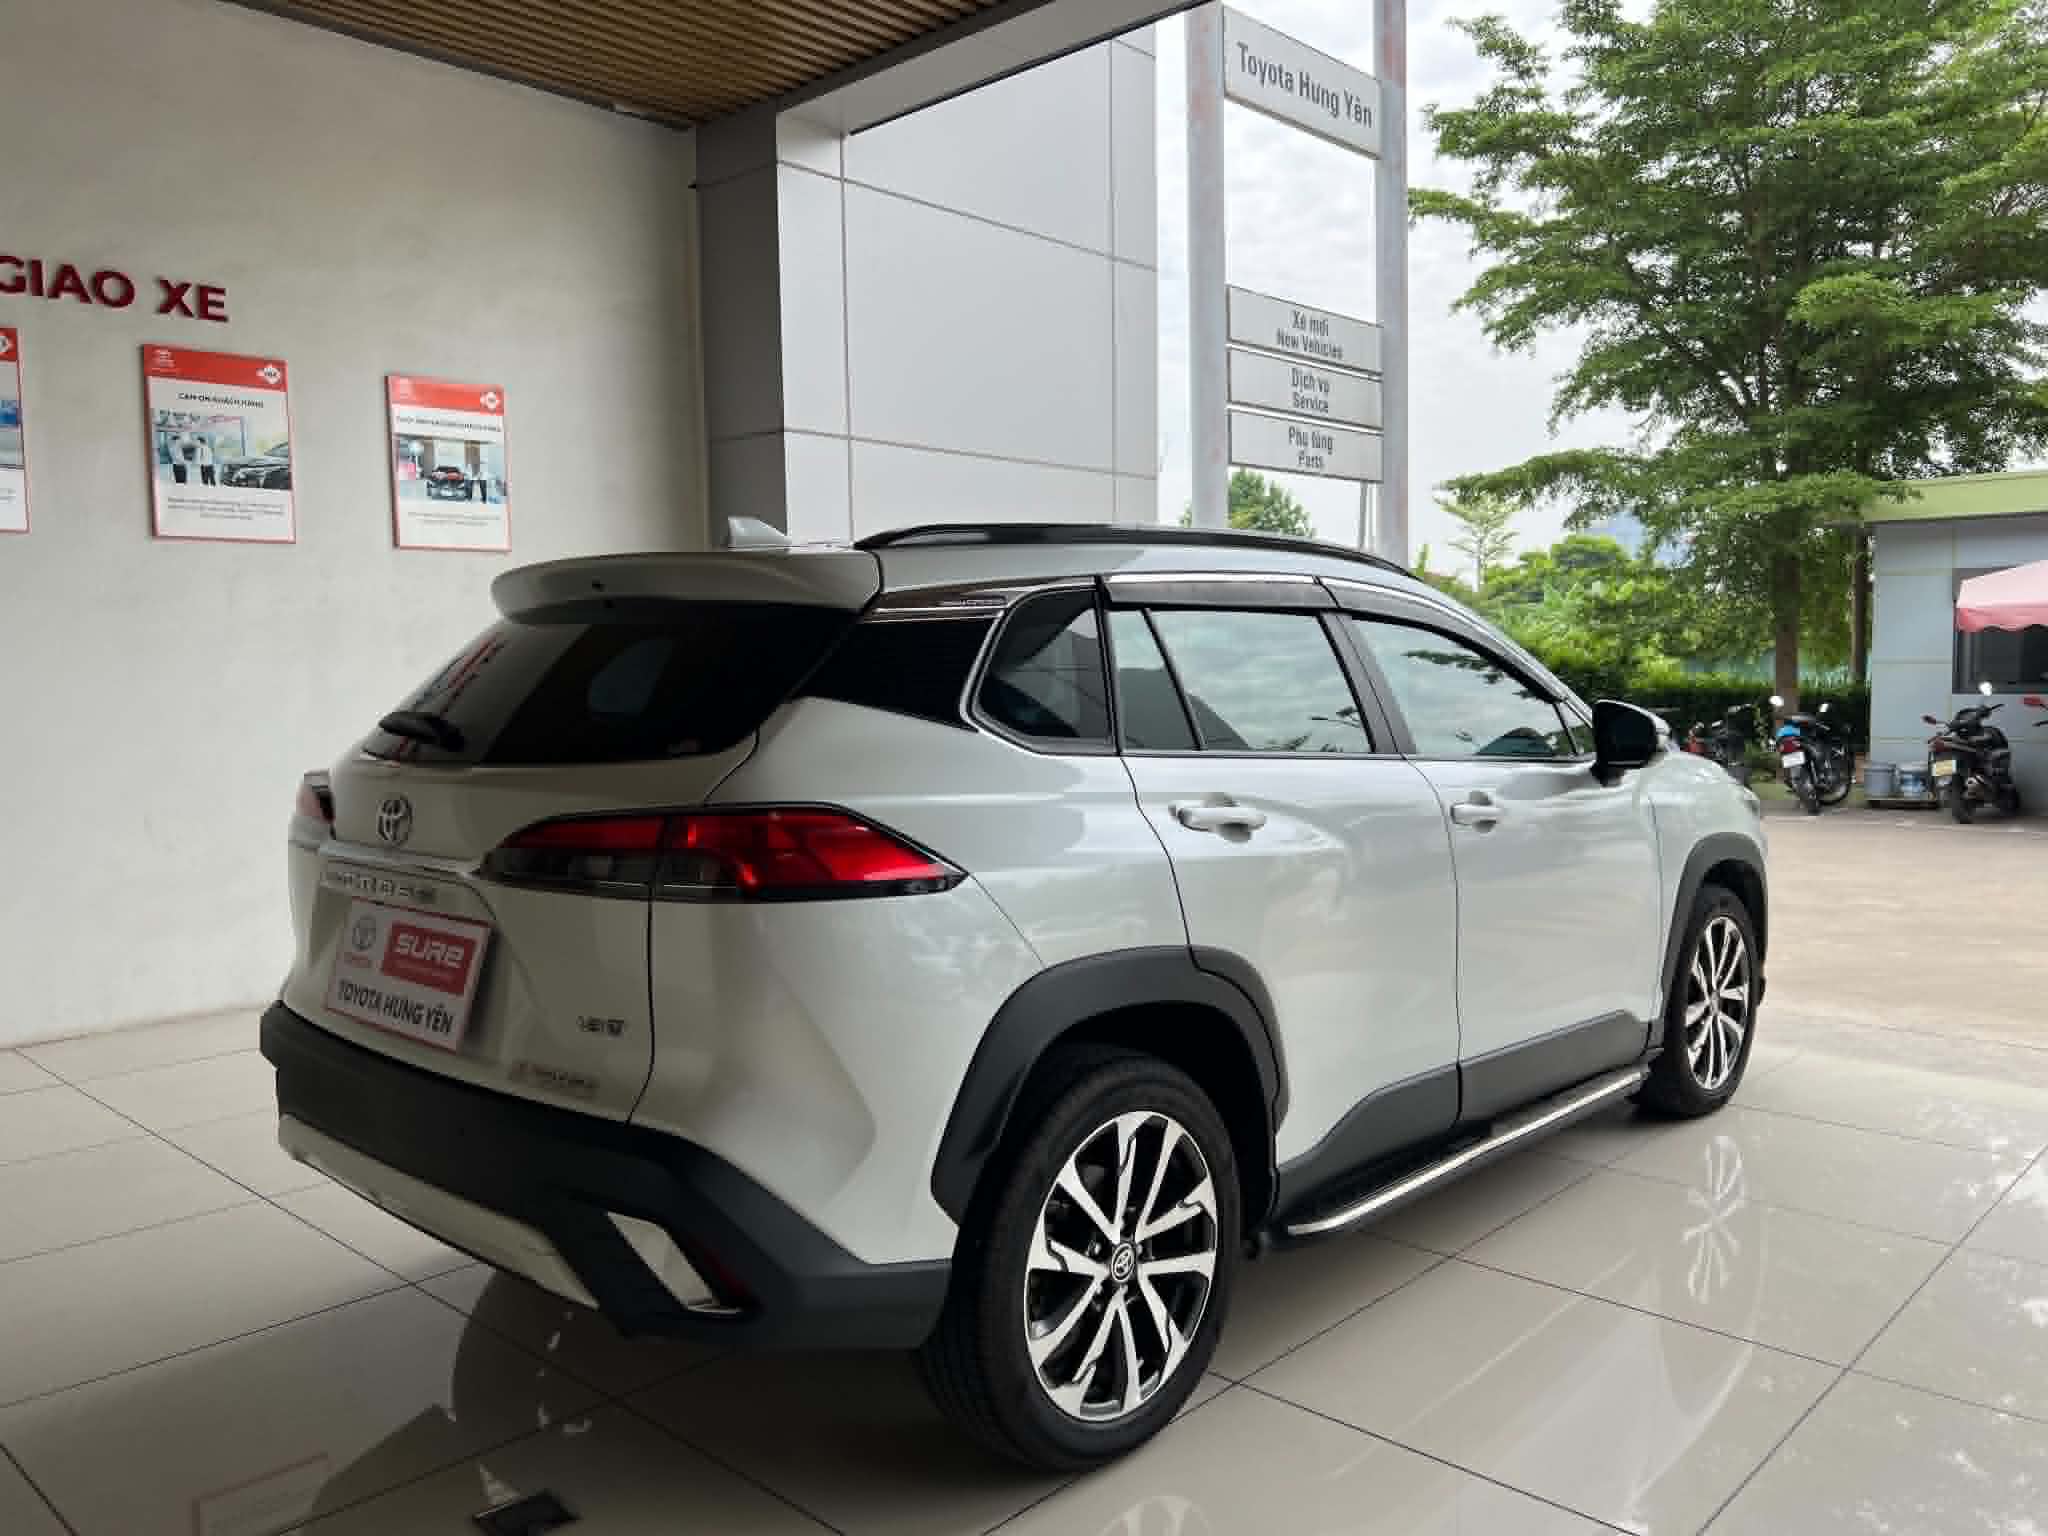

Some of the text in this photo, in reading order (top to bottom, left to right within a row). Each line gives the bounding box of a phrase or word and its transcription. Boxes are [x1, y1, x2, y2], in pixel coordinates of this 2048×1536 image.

[1237, 41, 1294, 92] Toyota
[0, 256, 229, 323] GIAO XE
[337, 978, 382, 1015] TOYOTA
